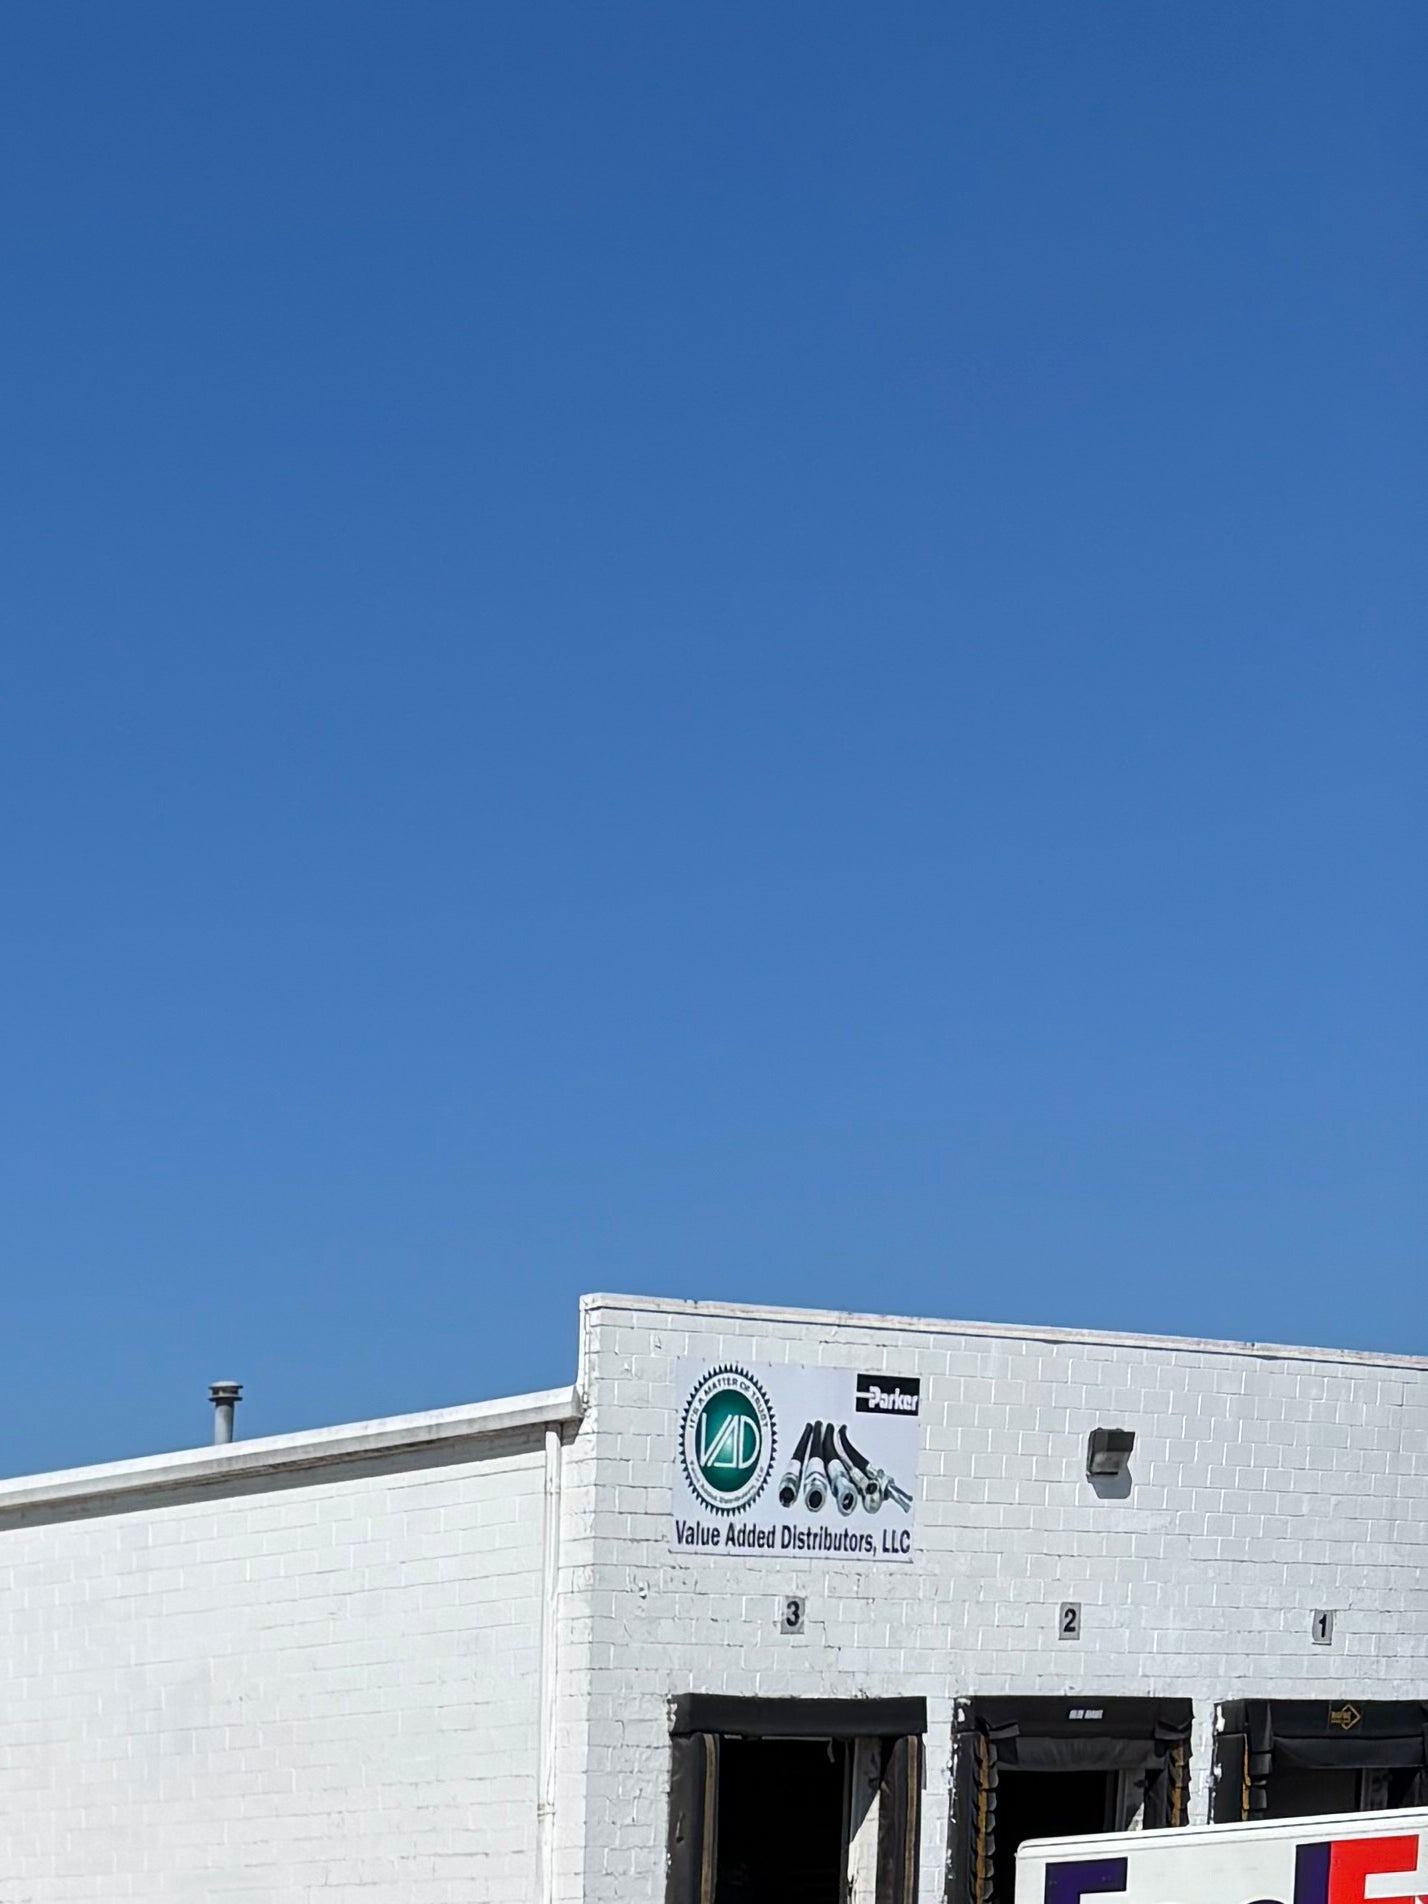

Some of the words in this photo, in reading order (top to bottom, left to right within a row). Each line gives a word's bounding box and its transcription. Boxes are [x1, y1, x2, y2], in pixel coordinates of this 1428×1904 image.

[868, 1385, 919, 1411] Parker
[675, 1519, 721, 1546] Value
[725, 1522, 776, 1549] Added
[882, 1529, 911, 1553] LLC
[786, 1601, 800, 1627] 3
[1064, 1608, 1076, 1632] 2
[1318, 1613, 1327, 1638] 1
